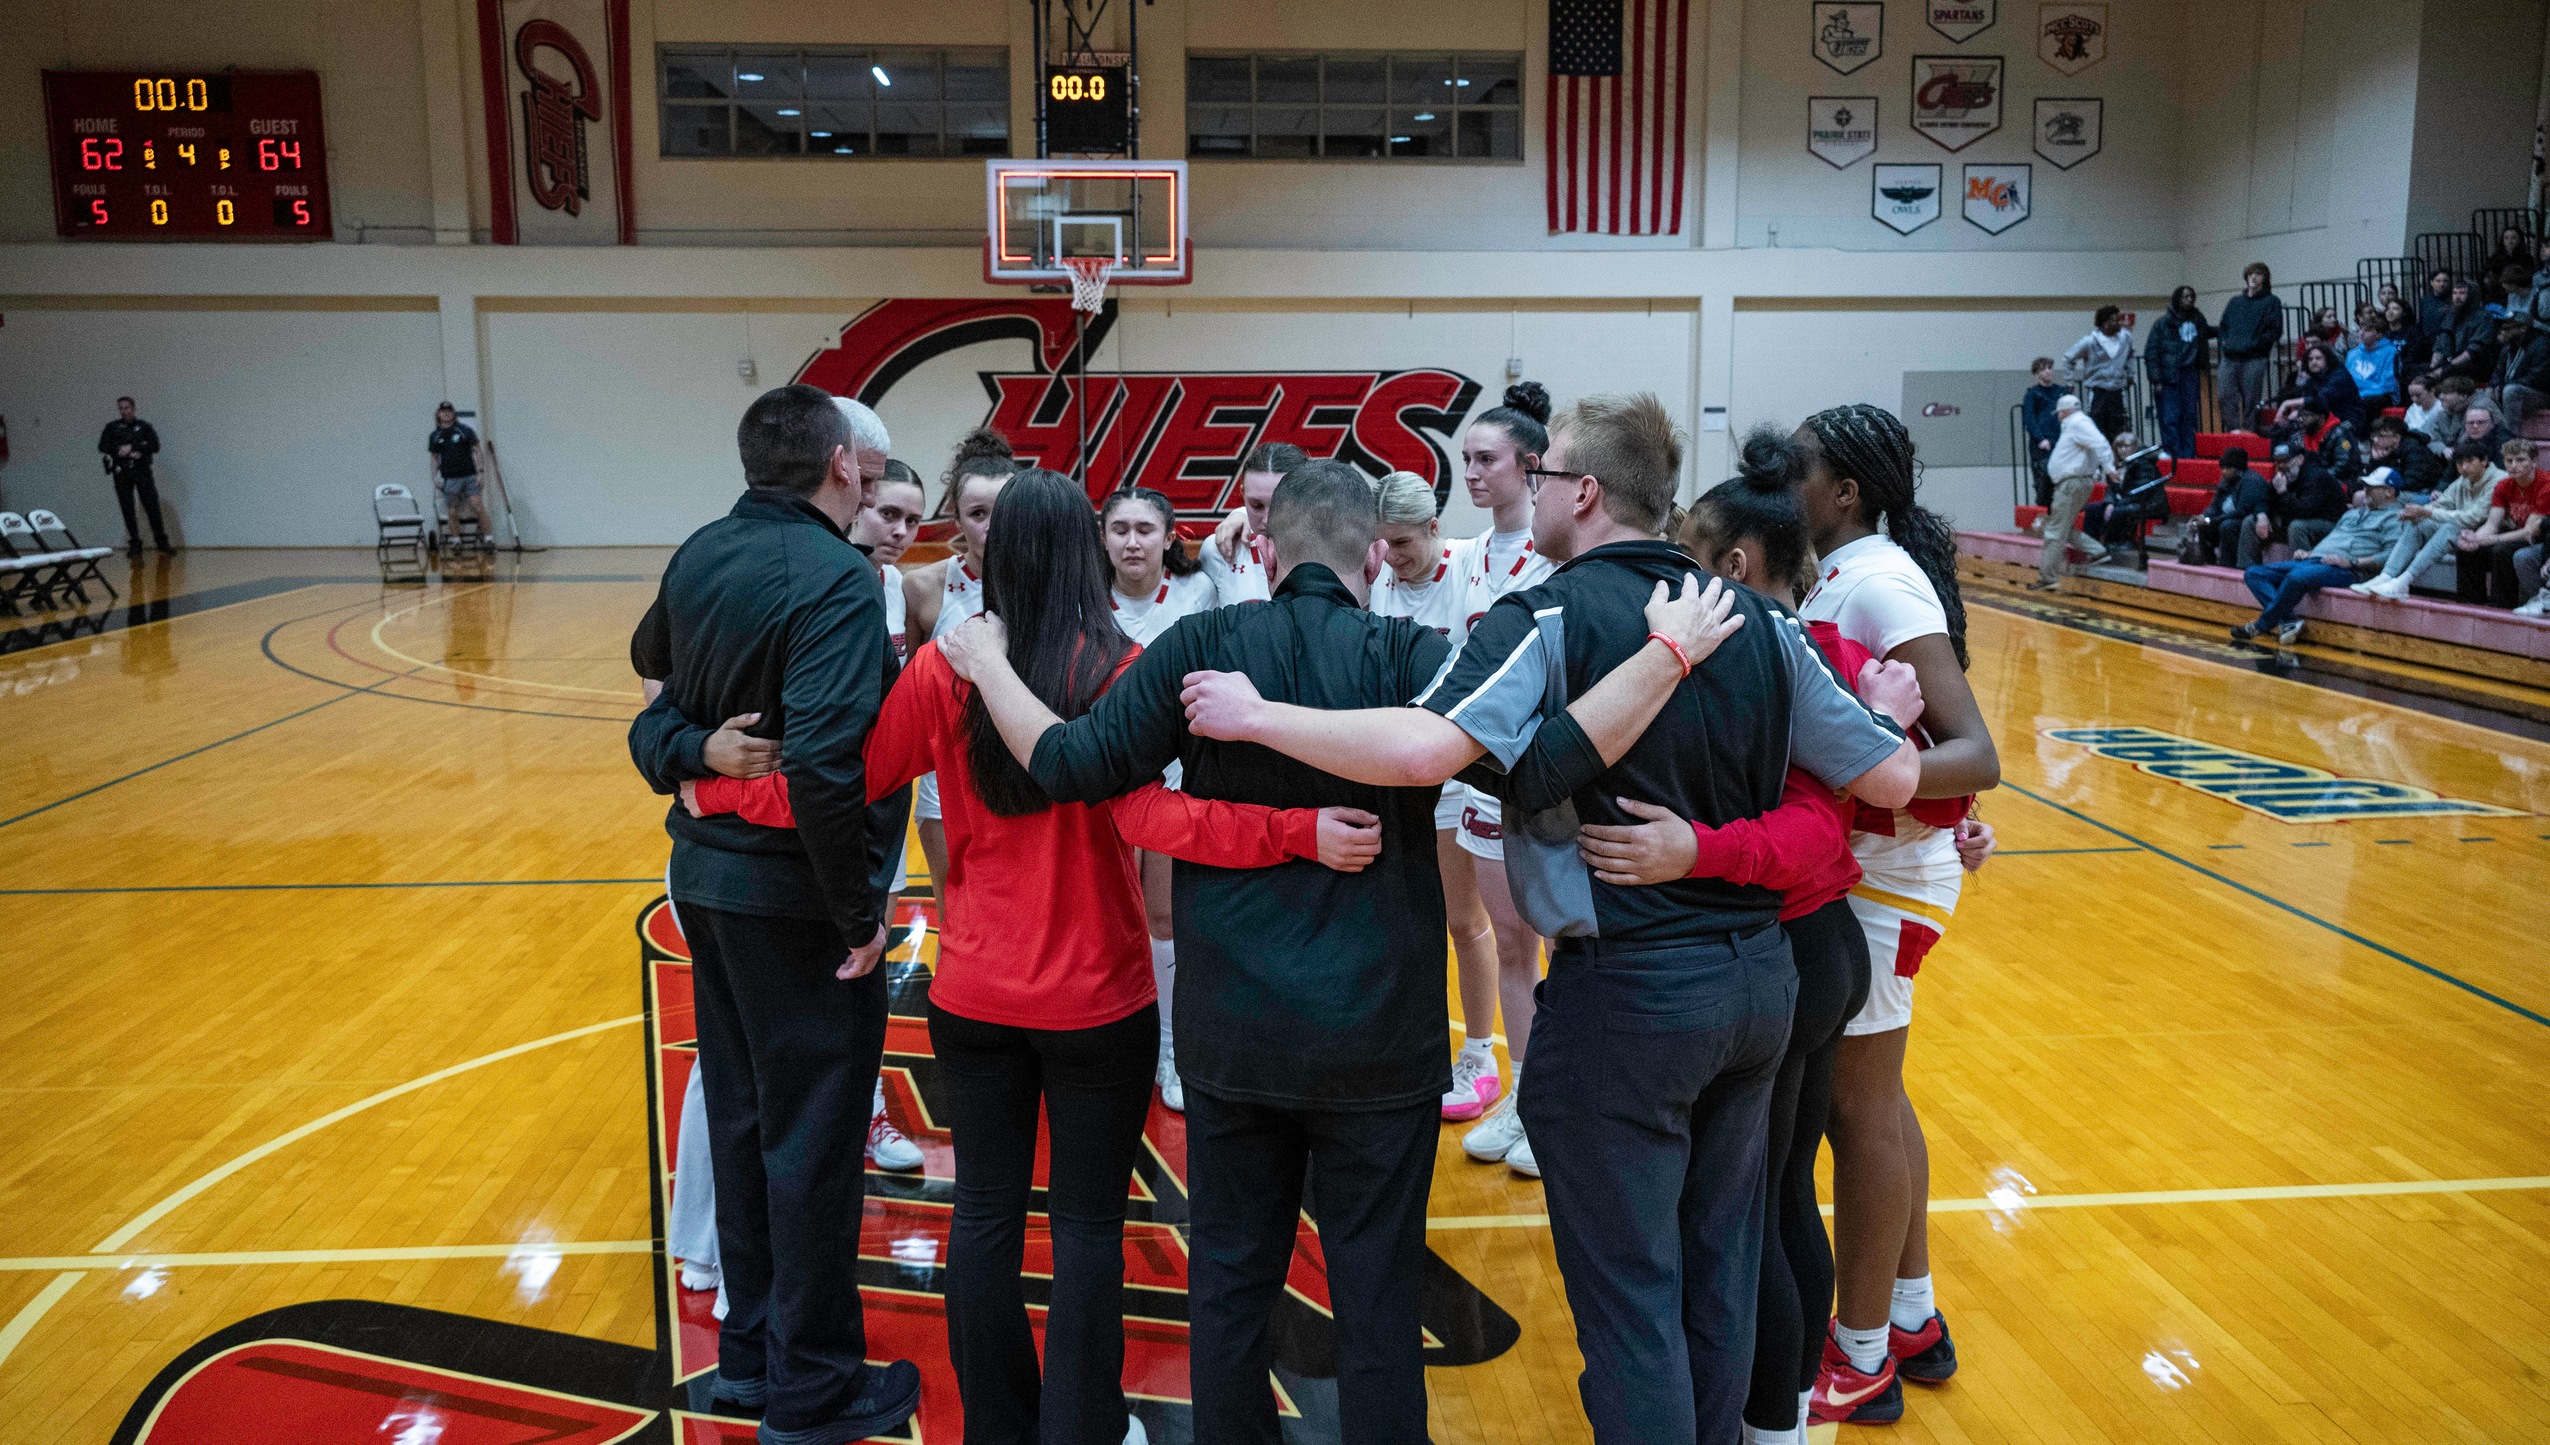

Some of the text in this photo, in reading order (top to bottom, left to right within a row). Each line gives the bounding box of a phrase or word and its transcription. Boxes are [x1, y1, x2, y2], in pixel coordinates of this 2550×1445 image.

[1934, 9, 1984, 21] SPARTANS
[134, 78, 208, 111] 00.0
[1052, 75, 1105, 100] 00.0
[74, 118, 118, 134] HOME
[250, 119, 298, 135] GUEST
[515, 18, 603, 217] CHIEFS
[168, 127, 205, 138] PERIOD
[81, 138, 123, 170] 62
[178, 143, 196, 166] 4
[258, 139, 301, 170] 64
[73, 184, 107, 196] FOULS
[275, 185, 309, 196] FOULS
[91, 199, 109, 225] 5
[151, 199, 168, 225] 0
[216, 199, 235, 225] 0
[293, 200, 310, 225] 5
[1892, 206, 1921, 215] OWLS
[784, 297, 1482, 547] CHIEFS
